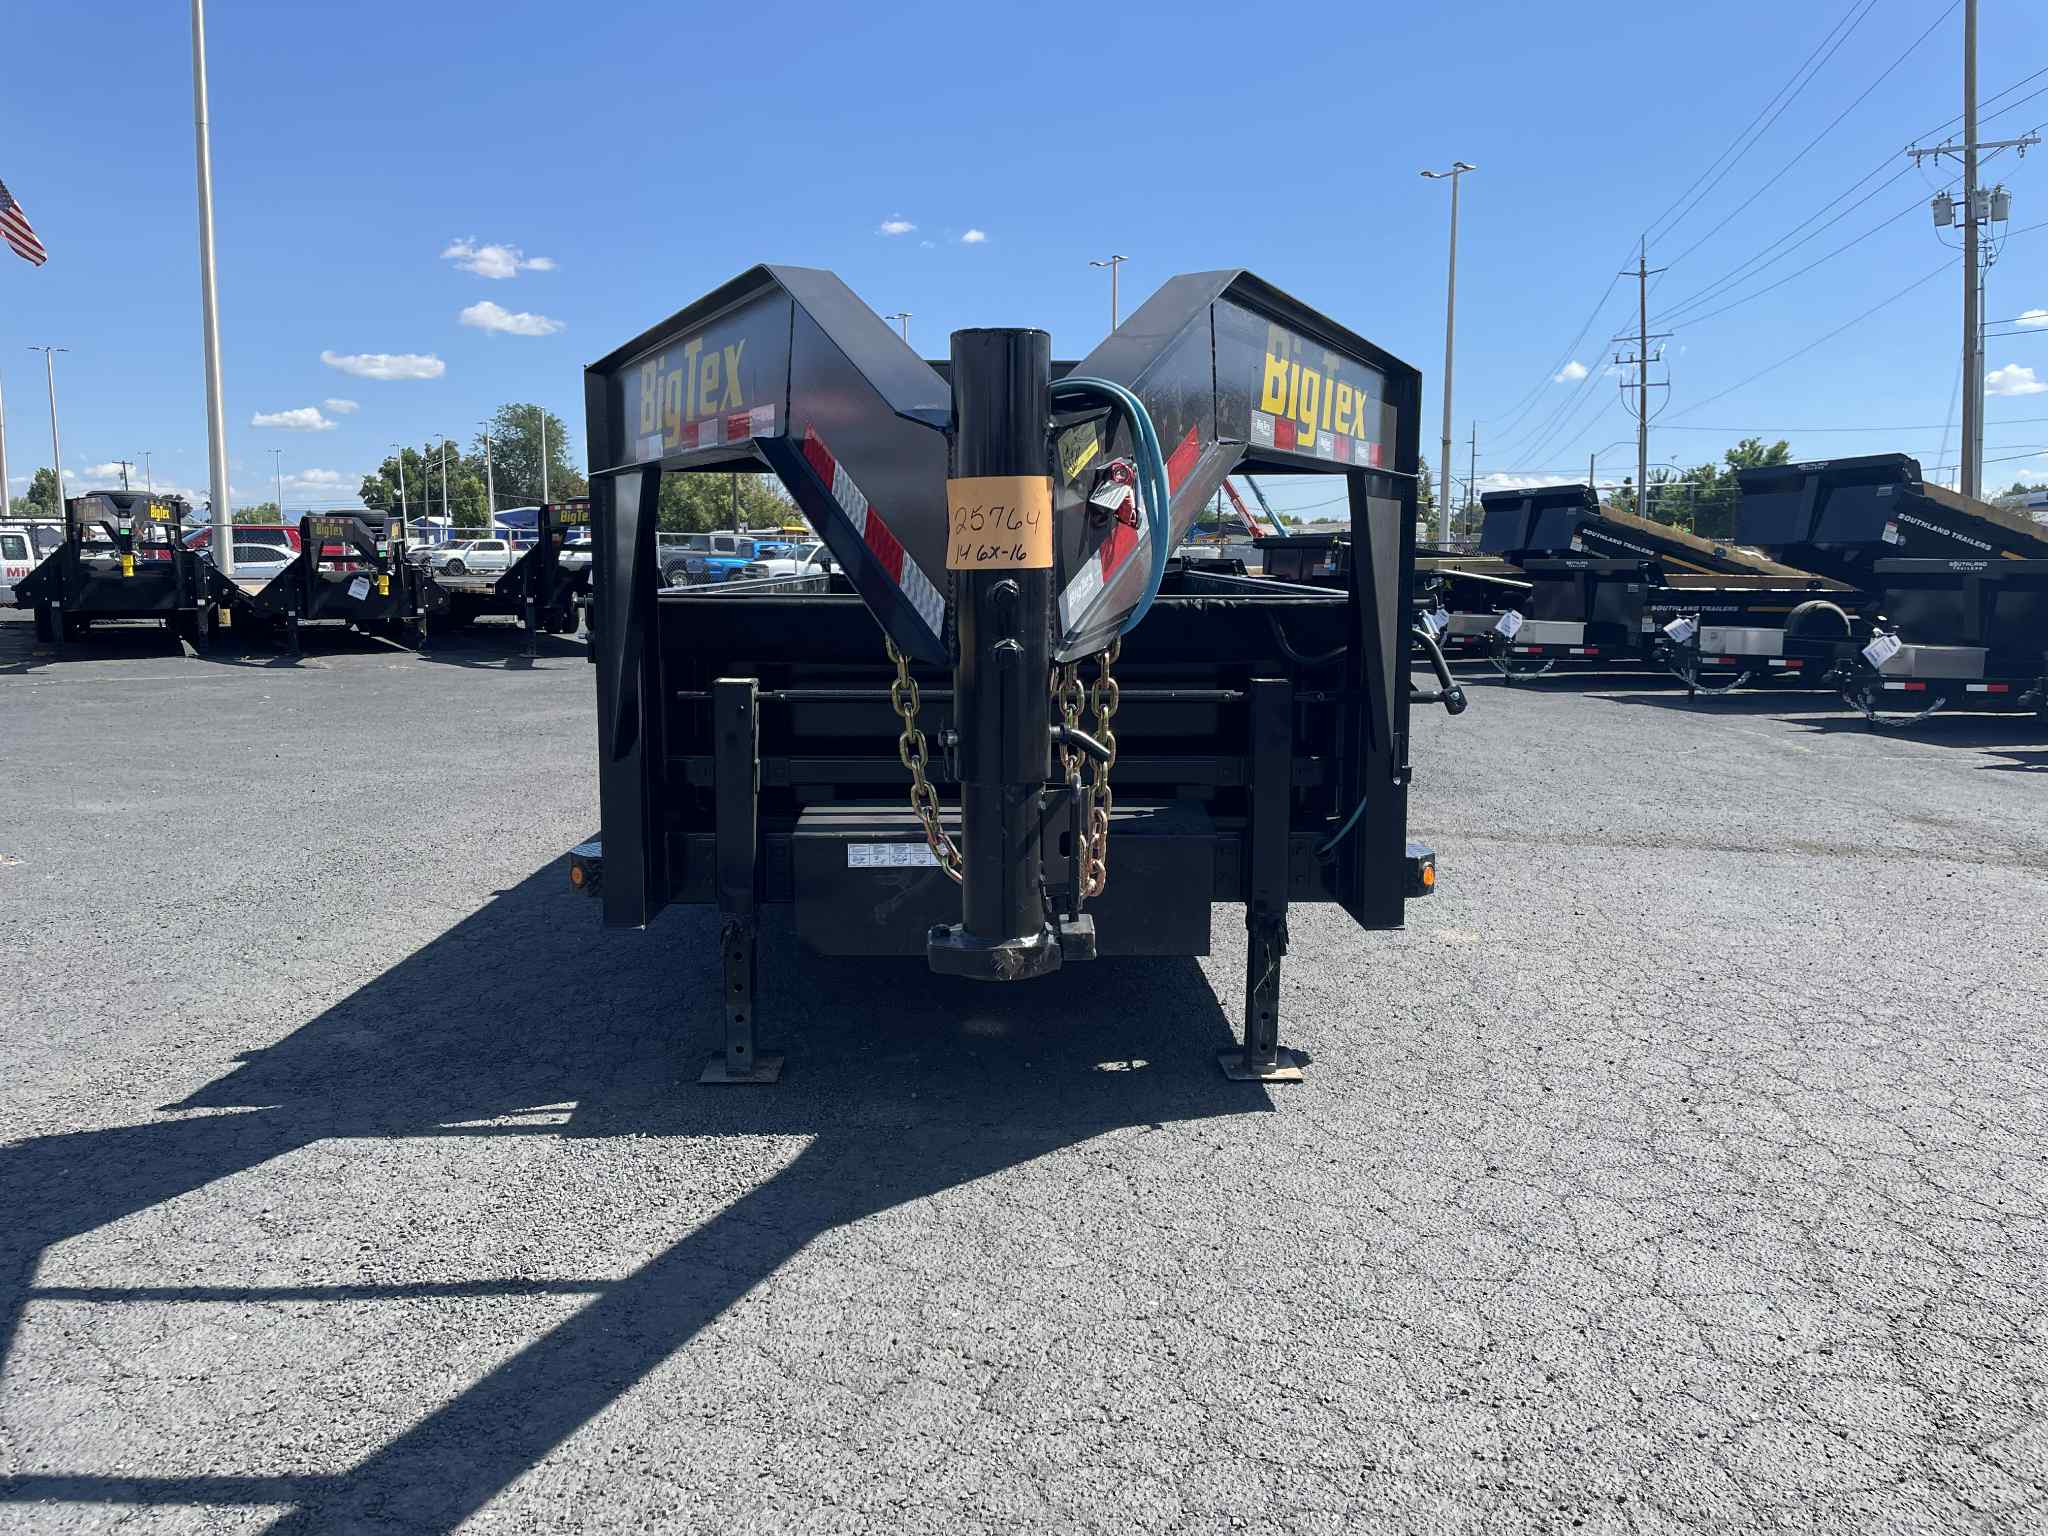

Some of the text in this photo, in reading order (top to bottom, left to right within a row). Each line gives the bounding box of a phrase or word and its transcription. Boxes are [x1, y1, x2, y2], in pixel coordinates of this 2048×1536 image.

[560, 510, 590, 525] BigTe
[955, 505, 1041, 535] 25764
[1897, 512, 1951, 536] SOUTHLAND
[1951, 531, 1993, 551] TRAILERS
